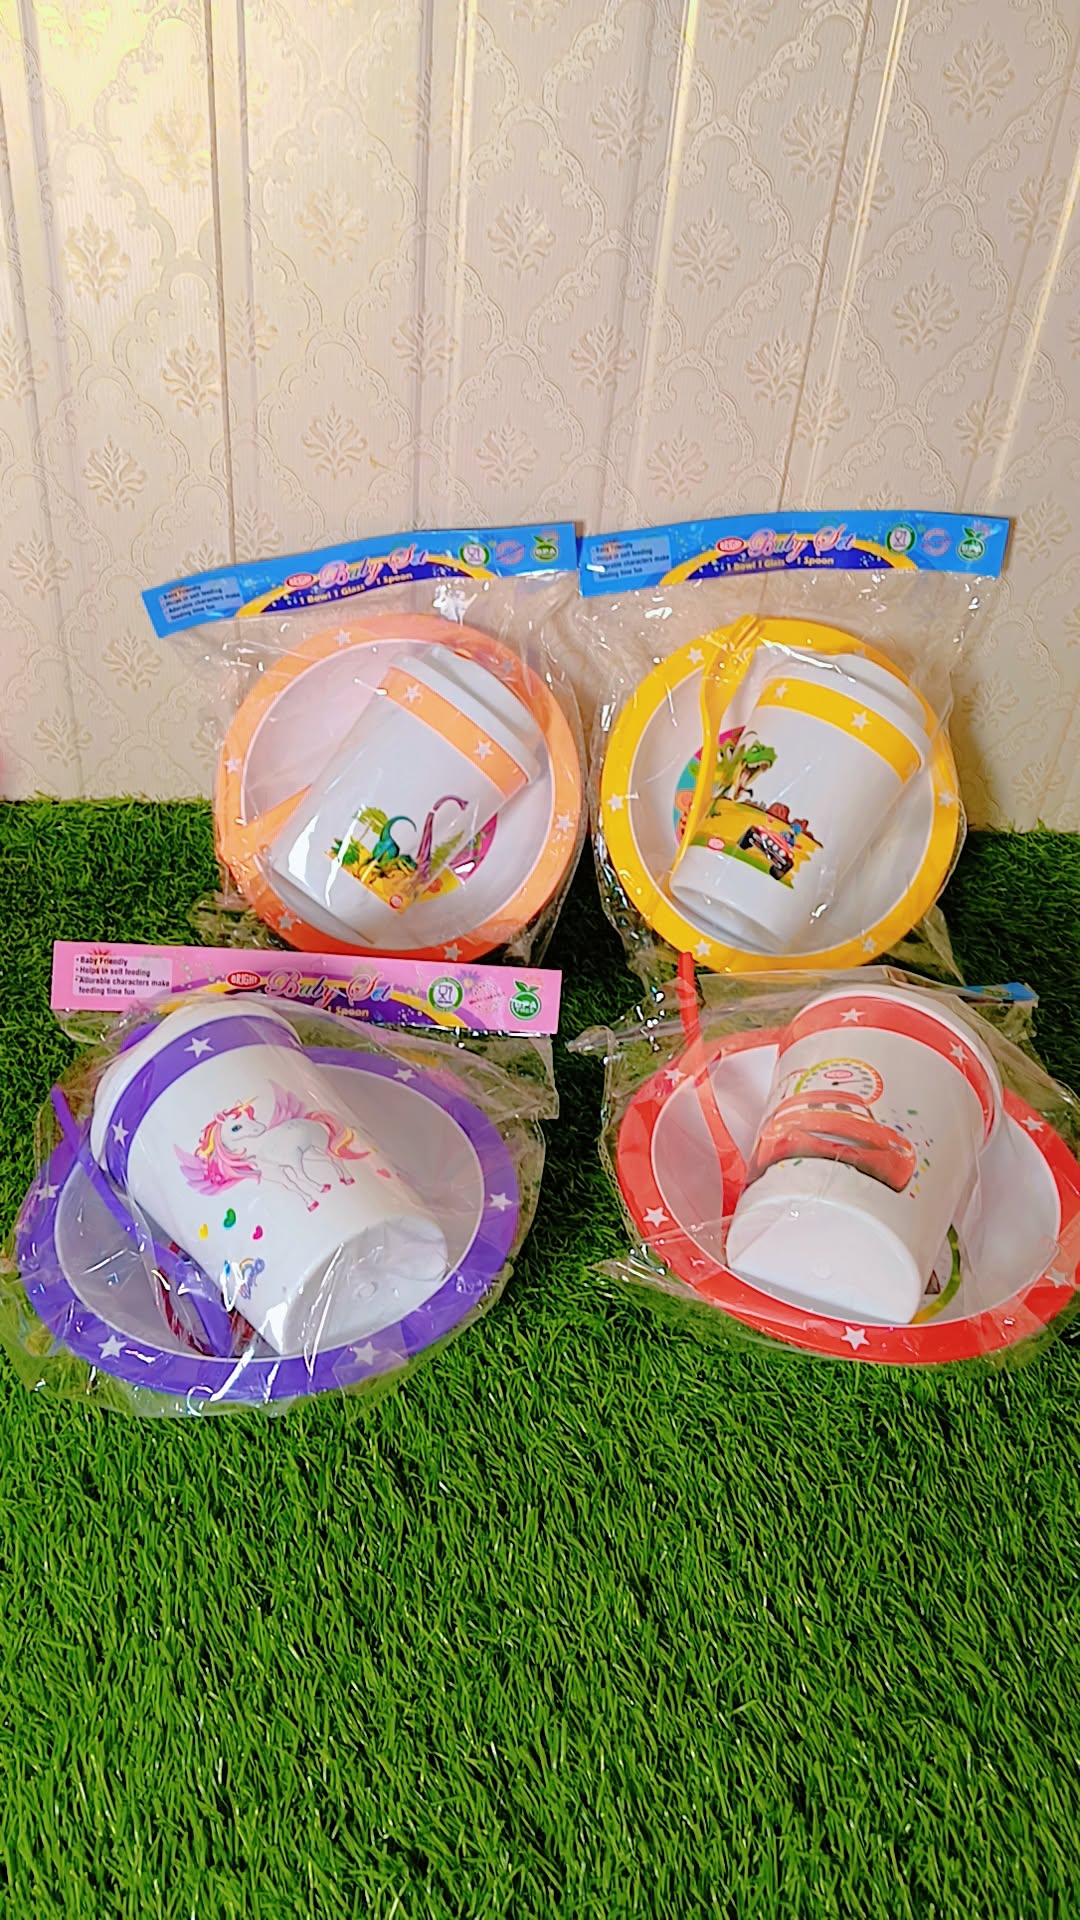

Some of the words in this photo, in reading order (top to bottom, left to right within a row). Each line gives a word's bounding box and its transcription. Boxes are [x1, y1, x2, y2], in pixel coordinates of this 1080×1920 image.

[748, 528, 808, 563] Baby
[814, 524, 856, 556] Set
[318, 557, 383, 588] Baby
[387, 543, 429, 574] Set
[804, 555, 834, 566] Spoon
[307, 592, 331, 603] Bowl
[341, 584, 366, 596] Glass
[383, 573, 413, 584] Spoon
[80, 957, 98, 965] Baby
[99, 957, 128, 967] Friendly
[79, 966, 100, 975] Helps
[101, 967, 108, 975] in
[124, 968, 151, 978] feeding
[79, 977, 110, 985] Adorable
[112, 978, 150, 986] characters
[230, 973, 259, 987] BRIGHT
[79, 987, 105, 996] feeding
[106, 987, 122, 995] time
[265, 967, 338, 1009] Baby
[347, 973, 394, 1006] Set
[335, 1005, 369, 1017] Spoon
